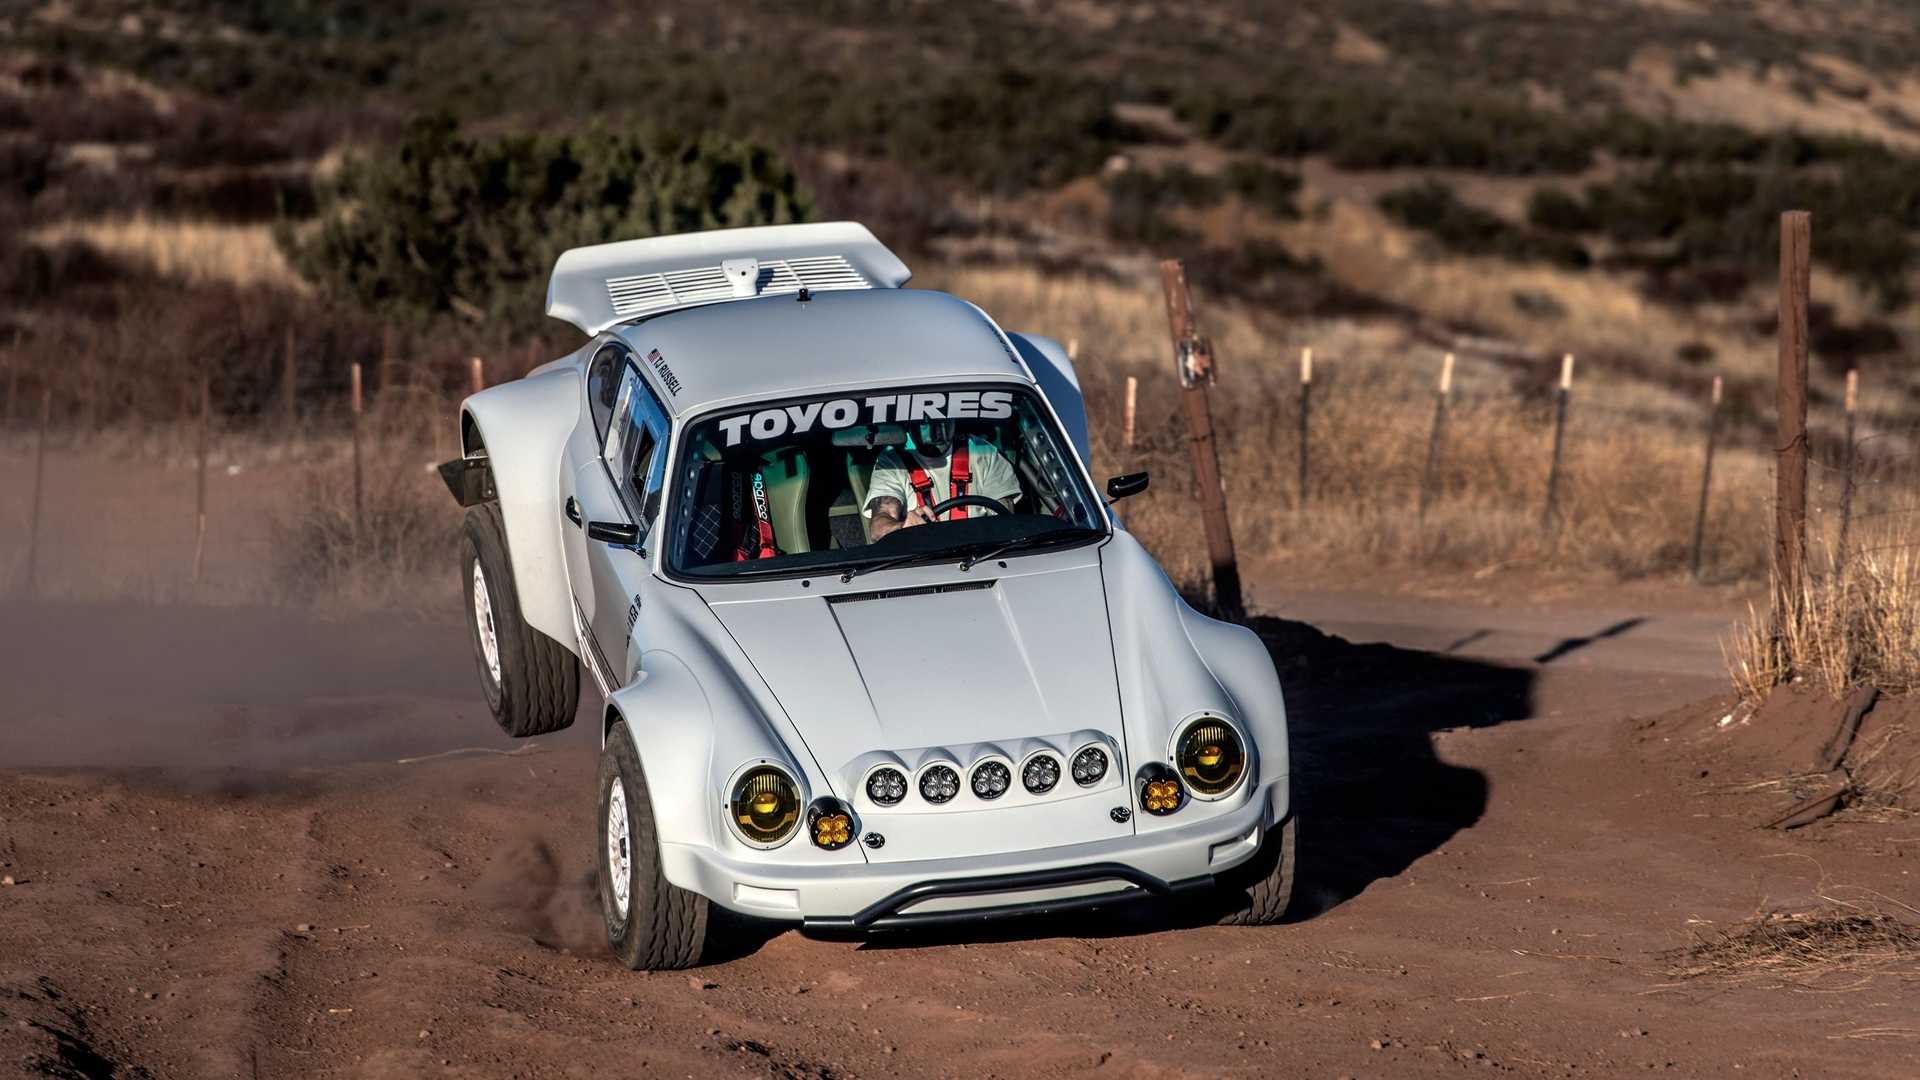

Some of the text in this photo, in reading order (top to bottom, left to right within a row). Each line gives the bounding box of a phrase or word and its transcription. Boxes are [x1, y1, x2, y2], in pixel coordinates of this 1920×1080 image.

[653, 356, 682, 397] TJ RUSSELL
[719, 391, 1013, 447] TOYO TIRES
